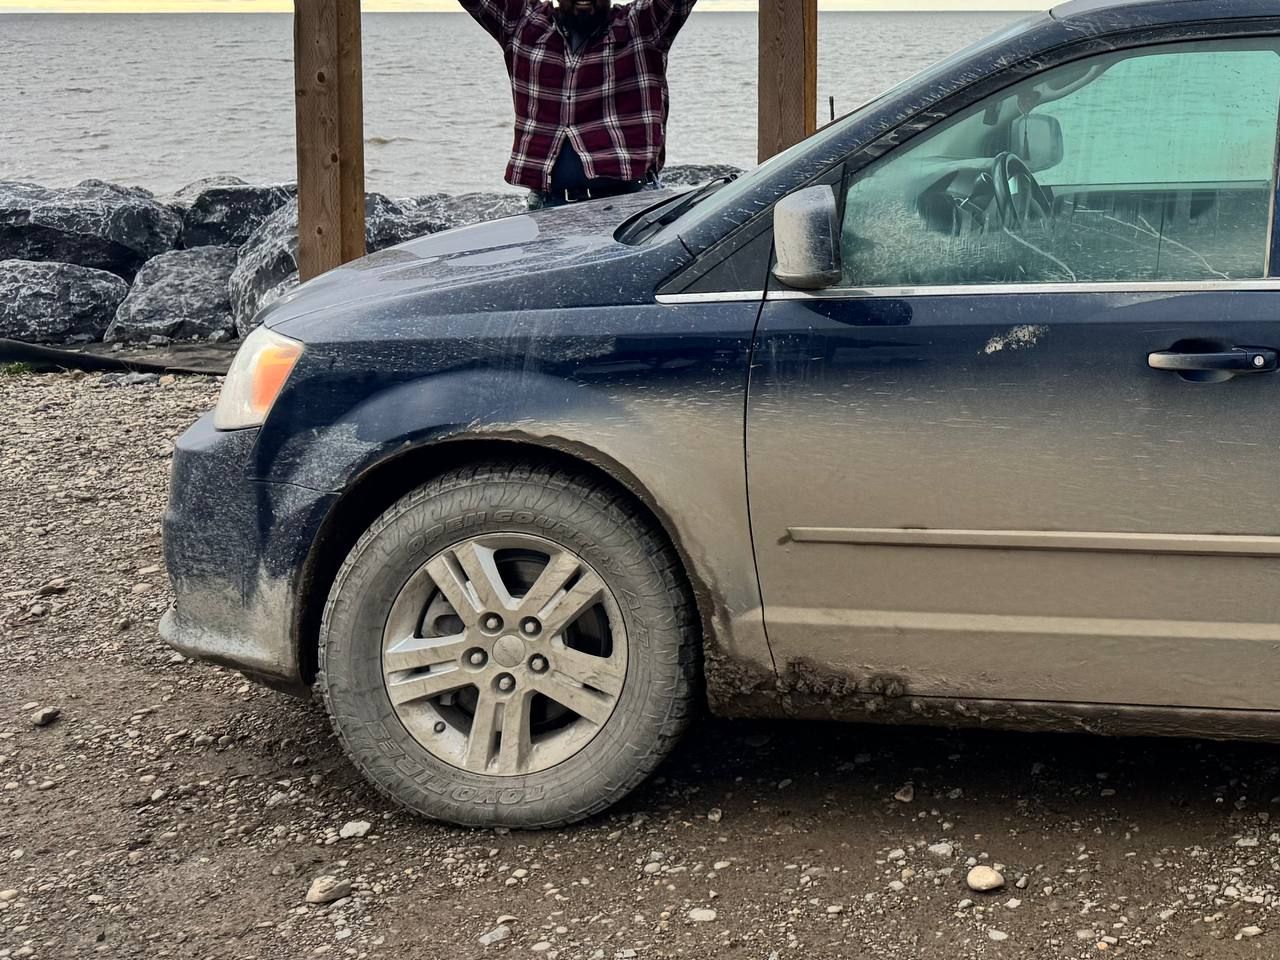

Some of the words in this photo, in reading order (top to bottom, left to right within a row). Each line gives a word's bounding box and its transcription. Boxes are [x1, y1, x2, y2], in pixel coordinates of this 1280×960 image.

[407, 510, 487, 555] OPEN
[364, 721, 451, 796] TIRES
[450, 785, 546, 805] TOYO
